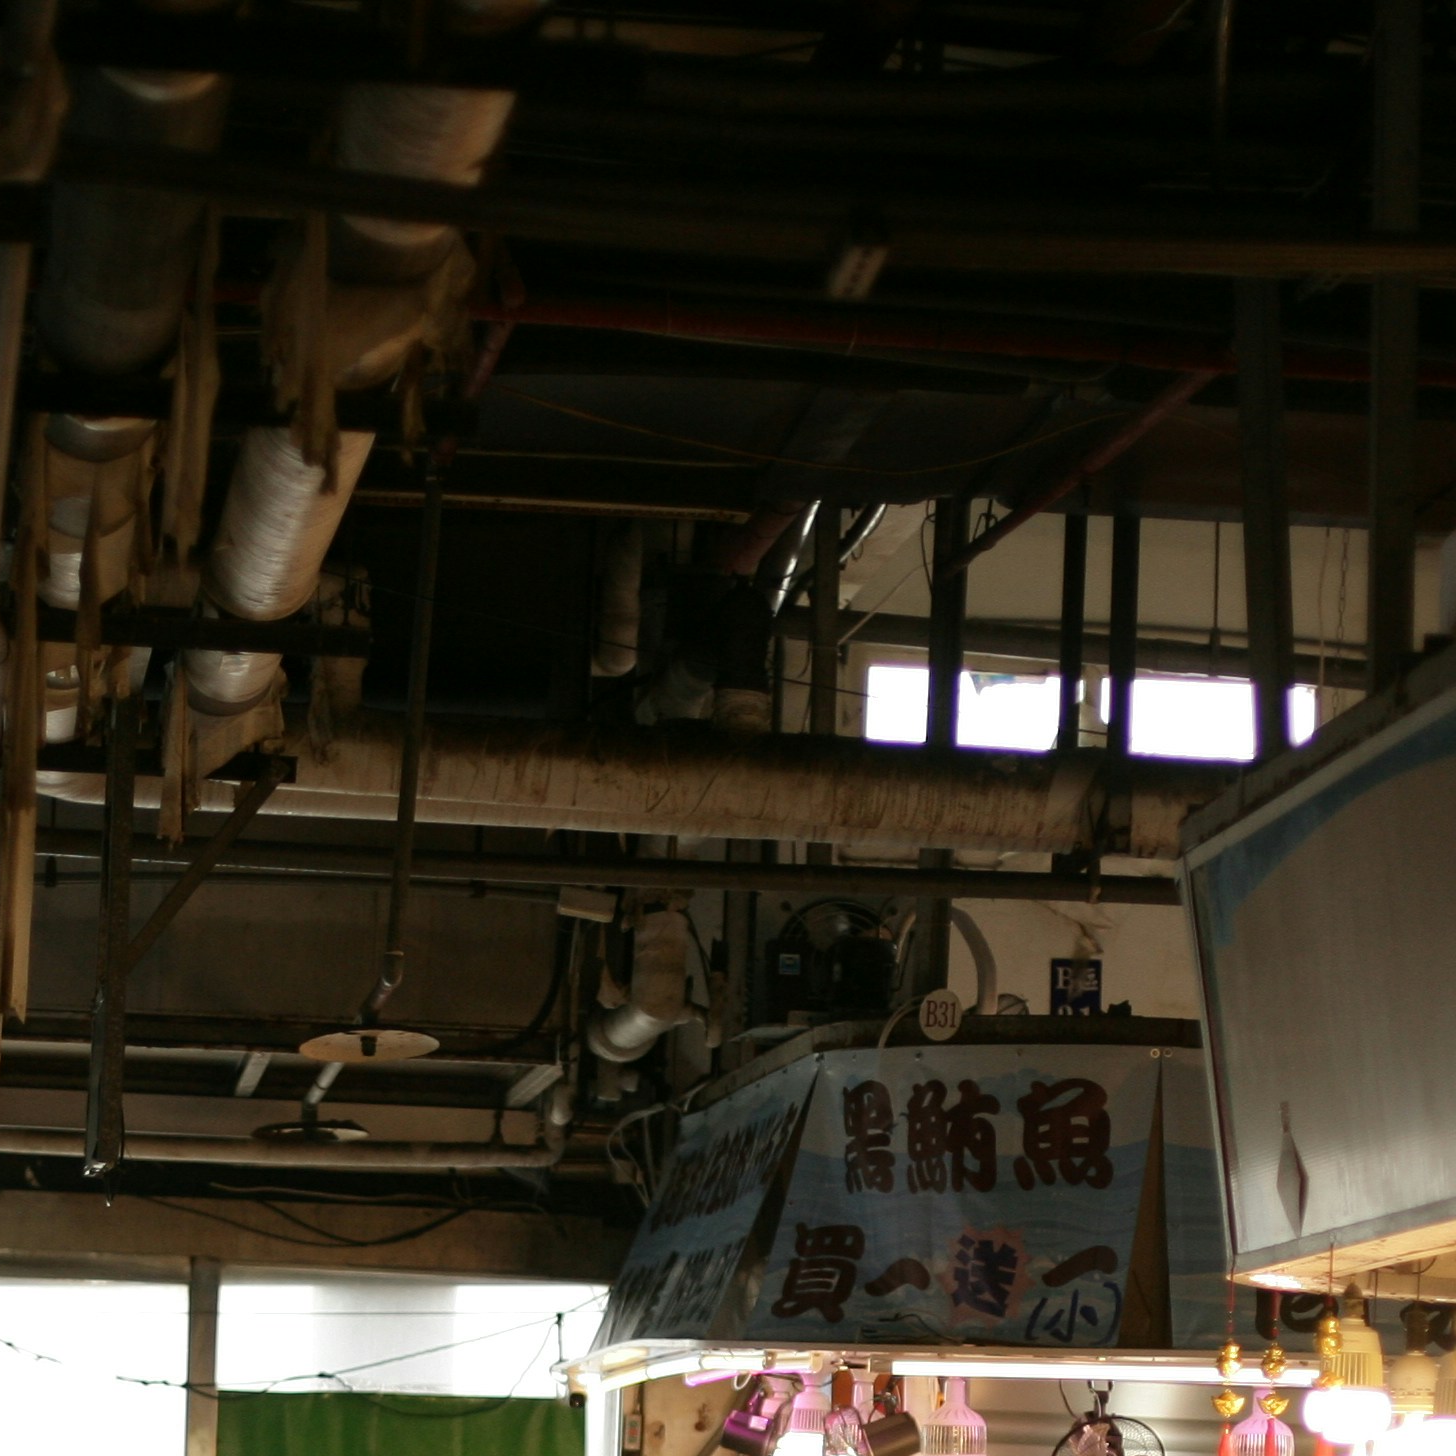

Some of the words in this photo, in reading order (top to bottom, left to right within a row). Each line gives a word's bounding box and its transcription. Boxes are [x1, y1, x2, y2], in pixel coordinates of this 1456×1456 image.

[925, 1000, 957, 1028] B31
[842, 1078, 1114, 1194] 黑鮪魚
[772, 1221, 1119, 1324] 買一送一
